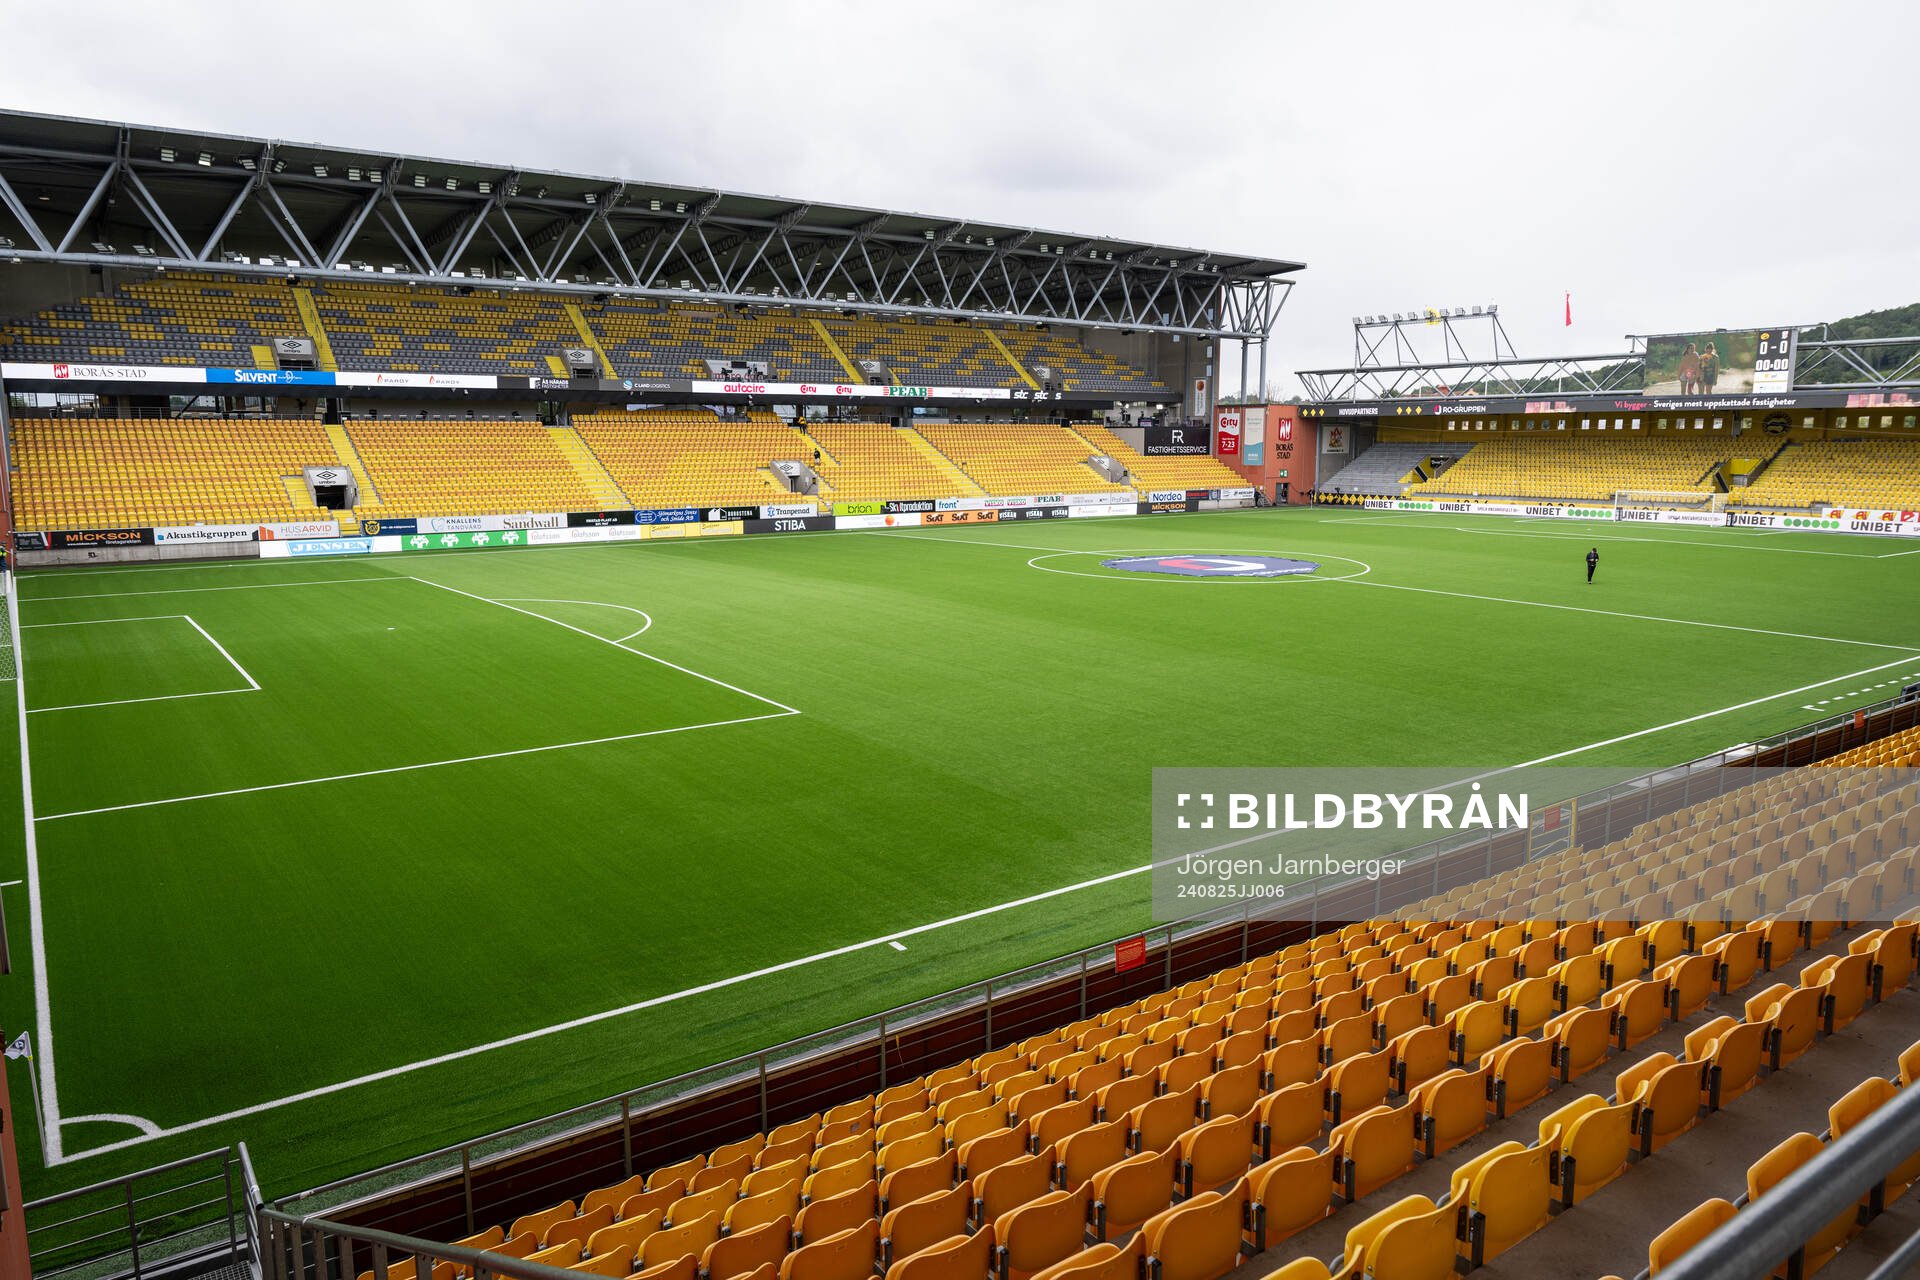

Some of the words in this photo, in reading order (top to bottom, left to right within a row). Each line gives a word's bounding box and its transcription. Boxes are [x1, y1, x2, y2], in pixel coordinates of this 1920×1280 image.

[1759, 341, 1768, 354] 0
[1779, 340, 1788, 354] 0
[1755, 358, 1789, 371] 00:00
[73, 367, 114, 378] BORÅS
[117, 368, 147, 378] STAD
[235, 370, 277, 383] SILVENT
[724, 384, 765, 393] autocirc
[889, 386, 928, 396] PEAB
[1624, 400, 1648, 410] bygger
[1654, 400, 1683, 410] Sveriges
[1704, 400, 1750, 410] uppskattade
[1752, 398, 1796, 408] fastigheter
[1276, 443, 1293, 451] BORÅS
[1153, 492, 1182, 502] Nordea
[848, 504, 872, 514] brion
[939, 500, 957, 509] front
[1365, 500, 1393, 509] UNIBET
[1440, 503, 1471, 512] UNIBET
[1526, 507, 1561, 516] UNIBET
[1622, 511, 1659, 520] UNIBET
[504, 516, 559, 530] Sandwall
[1851, 521, 1903, 532] UNIBET
[166, 530, 248, 540] Akustikgruppen
[292, 540, 368, 552] JENSEN
